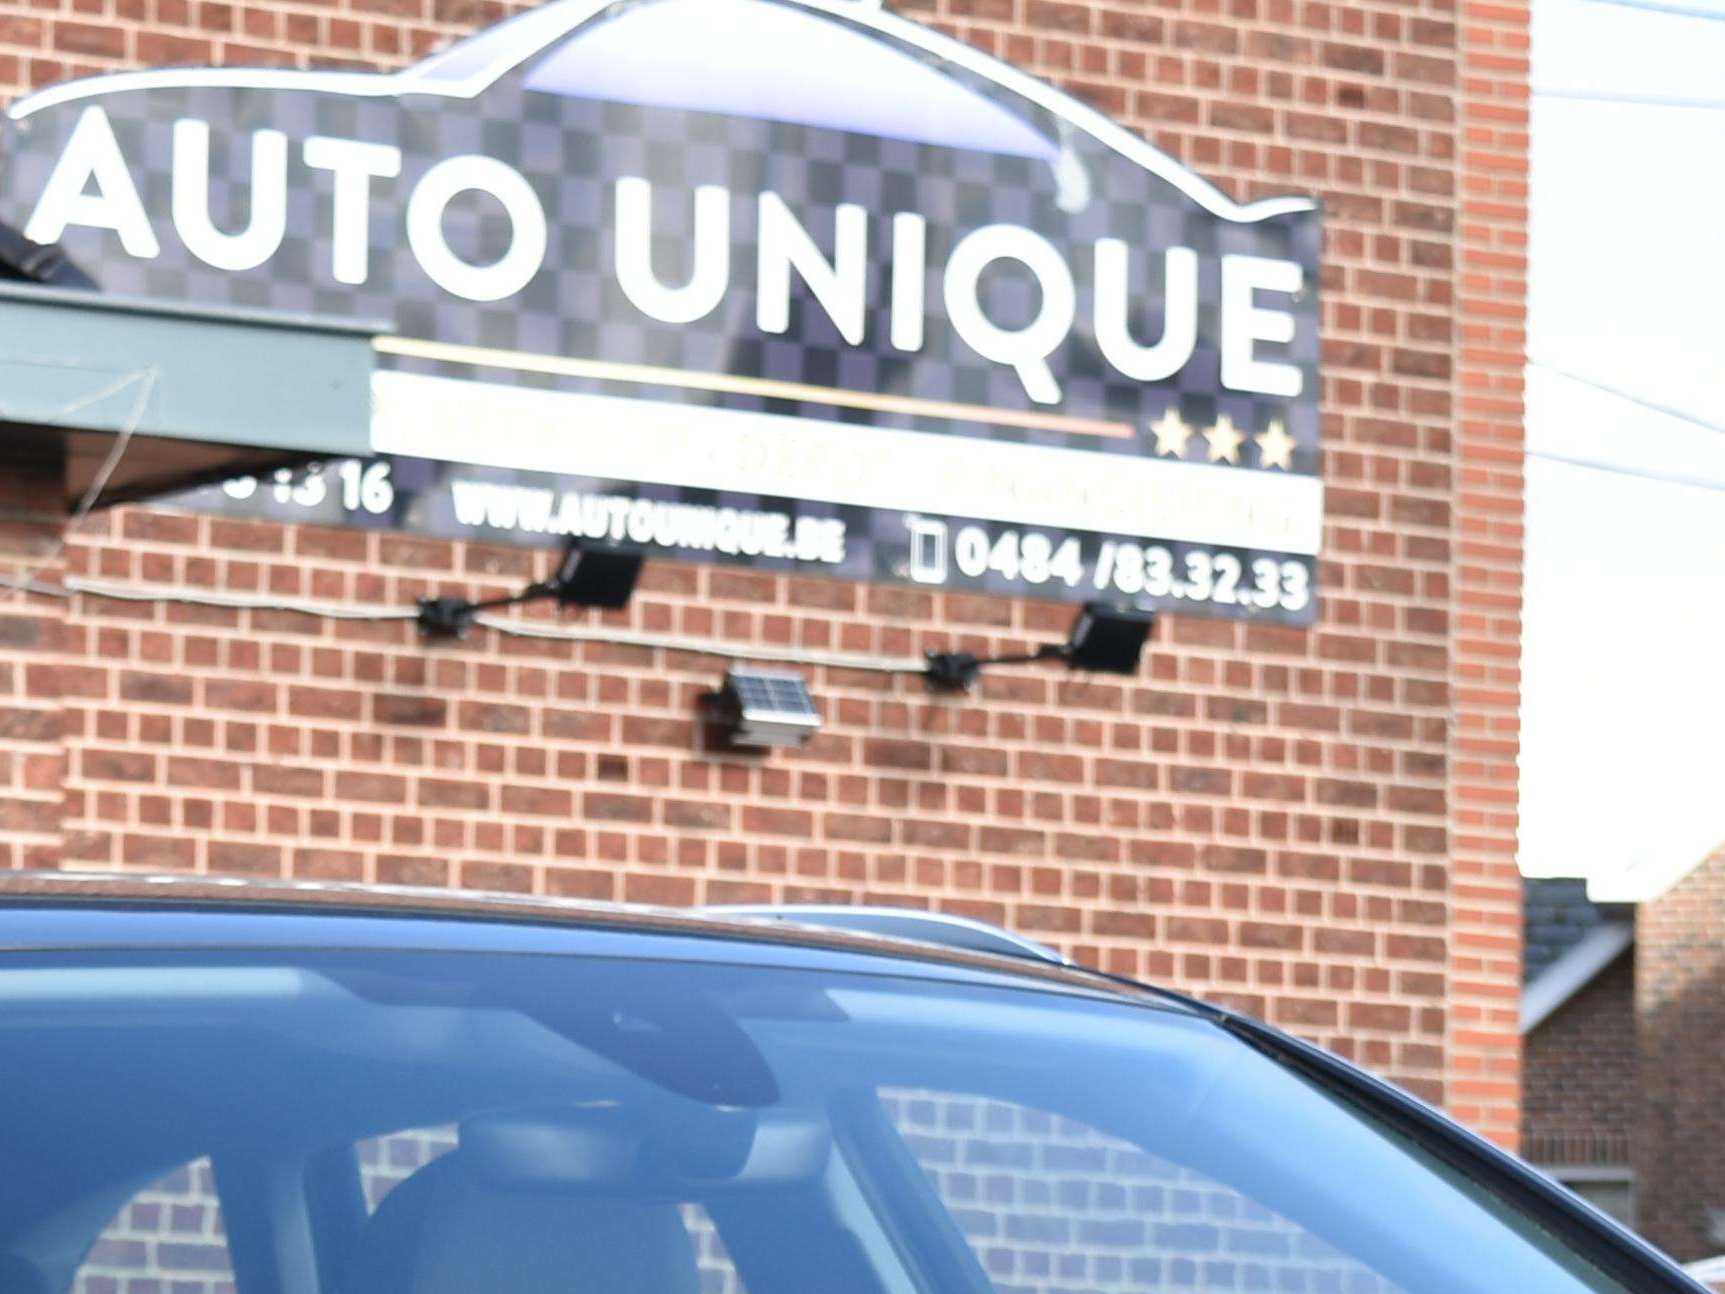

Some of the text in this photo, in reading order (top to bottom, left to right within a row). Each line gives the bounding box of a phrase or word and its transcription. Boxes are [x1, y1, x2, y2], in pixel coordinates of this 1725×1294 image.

[24, 105, 1304, 405] AUTO UNIQUE
[339, 459, 394, 514] 16
[954, 526, 1083, 587] 0484
